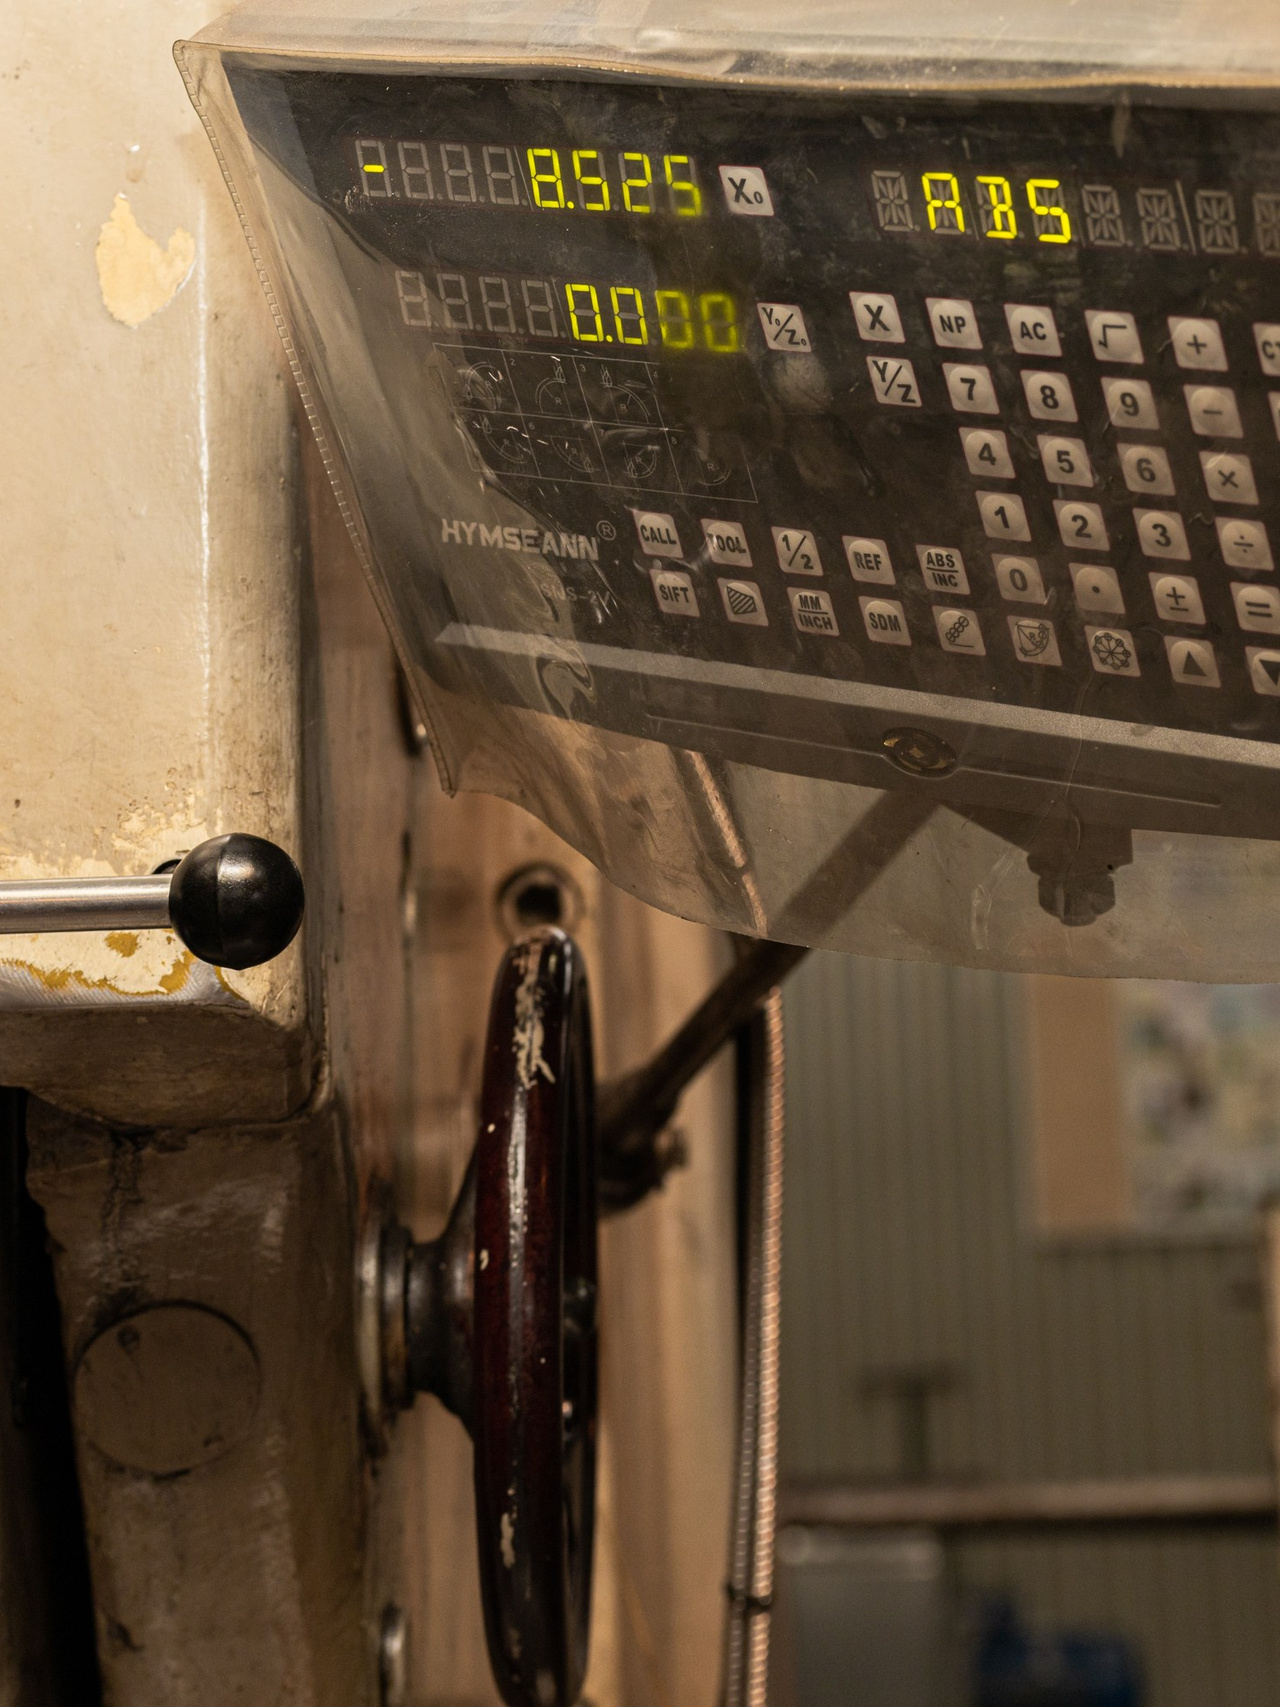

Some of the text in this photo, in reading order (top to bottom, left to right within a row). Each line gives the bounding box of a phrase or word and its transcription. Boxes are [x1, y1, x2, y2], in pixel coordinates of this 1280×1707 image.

[527, 148, 702, 217] 8.525
[921, 172, 1072, 244] ABS
[564, 282, 743, 353] 0.000
[864, 304, 890, 332] X
[939, 315, 966, 334] NP
[1020, 321, 1046, 340] AC
[960, 377, 976, 401] 7
[1040, 385, 1060, 409] 8
[1120, 392, 1140, 417] 9
[978, 443, 997, 466] 4
[1056, 449, 1075, 474] 5
[1136, 458, 1156, 483] 6
[994, 505, 1010, 529] 1
[1071, 514, 1092, 539] 2
[640, 524, 677, 546] CALL
[1152, 523, 1172, 548] 3
[853, 551, 882, 571] REF
[926, 551, 956, 569] ABS
[932, 572, 959, 588] INC
[1009, 568, 1028, 592] 0
[659, 583, 690, 604] SIFT
[799, 594, 822, 611] MM
[799, 613, 834, 631] INCH
[868, 611, 902, 632] SDM
